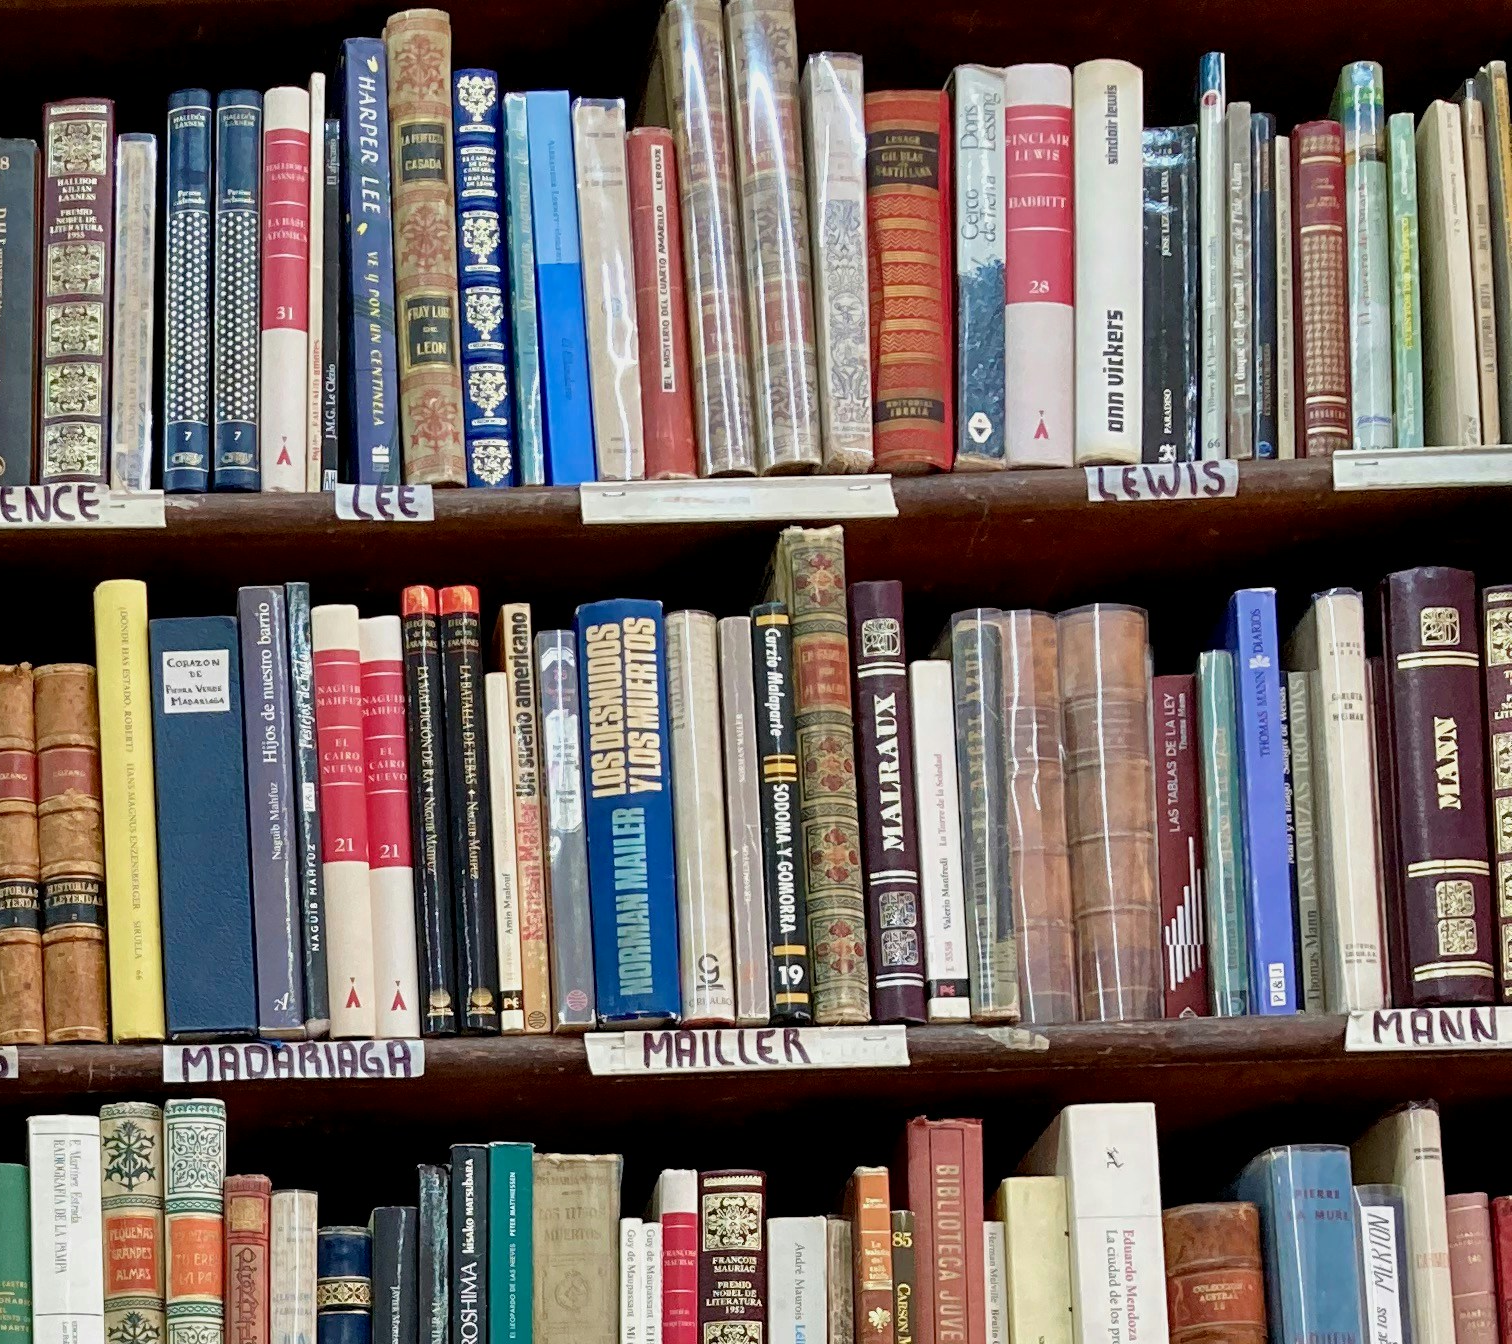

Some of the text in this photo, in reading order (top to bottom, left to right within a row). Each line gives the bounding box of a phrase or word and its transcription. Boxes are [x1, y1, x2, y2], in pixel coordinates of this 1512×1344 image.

[358, 75, 381, 216] HARPER LEE
[1028, 280, 1050, 294] 28
[1102, 310, 1125, 434] ann vickers
[351, 484, 416, 521] LEE
[1097, 461, 1227, 498] LEWIS
[585, 622, 627, 799] LOS DESNUDOS
[622, 616, 662, 795] Y LOS MUERTOS
[873, 692, 904, 853] MALRAUX
[1434, 716, 1462, 810] MANN
[334, 837, 354, 854] 21
[773, 783, 797, 935] SODOMA Y GOMORRA
[612, 806, 653, 997] NORMAN MAILER
[778, 963, 803, 985] 19
[181, 1041, 413, 1078] MADARIAGA
[643, 1028, 811, 1066] MAILLER
[1372, 1009, 1499, 1045] MANN
[935, 1164, 962, 1282] BIBLIOTECA
